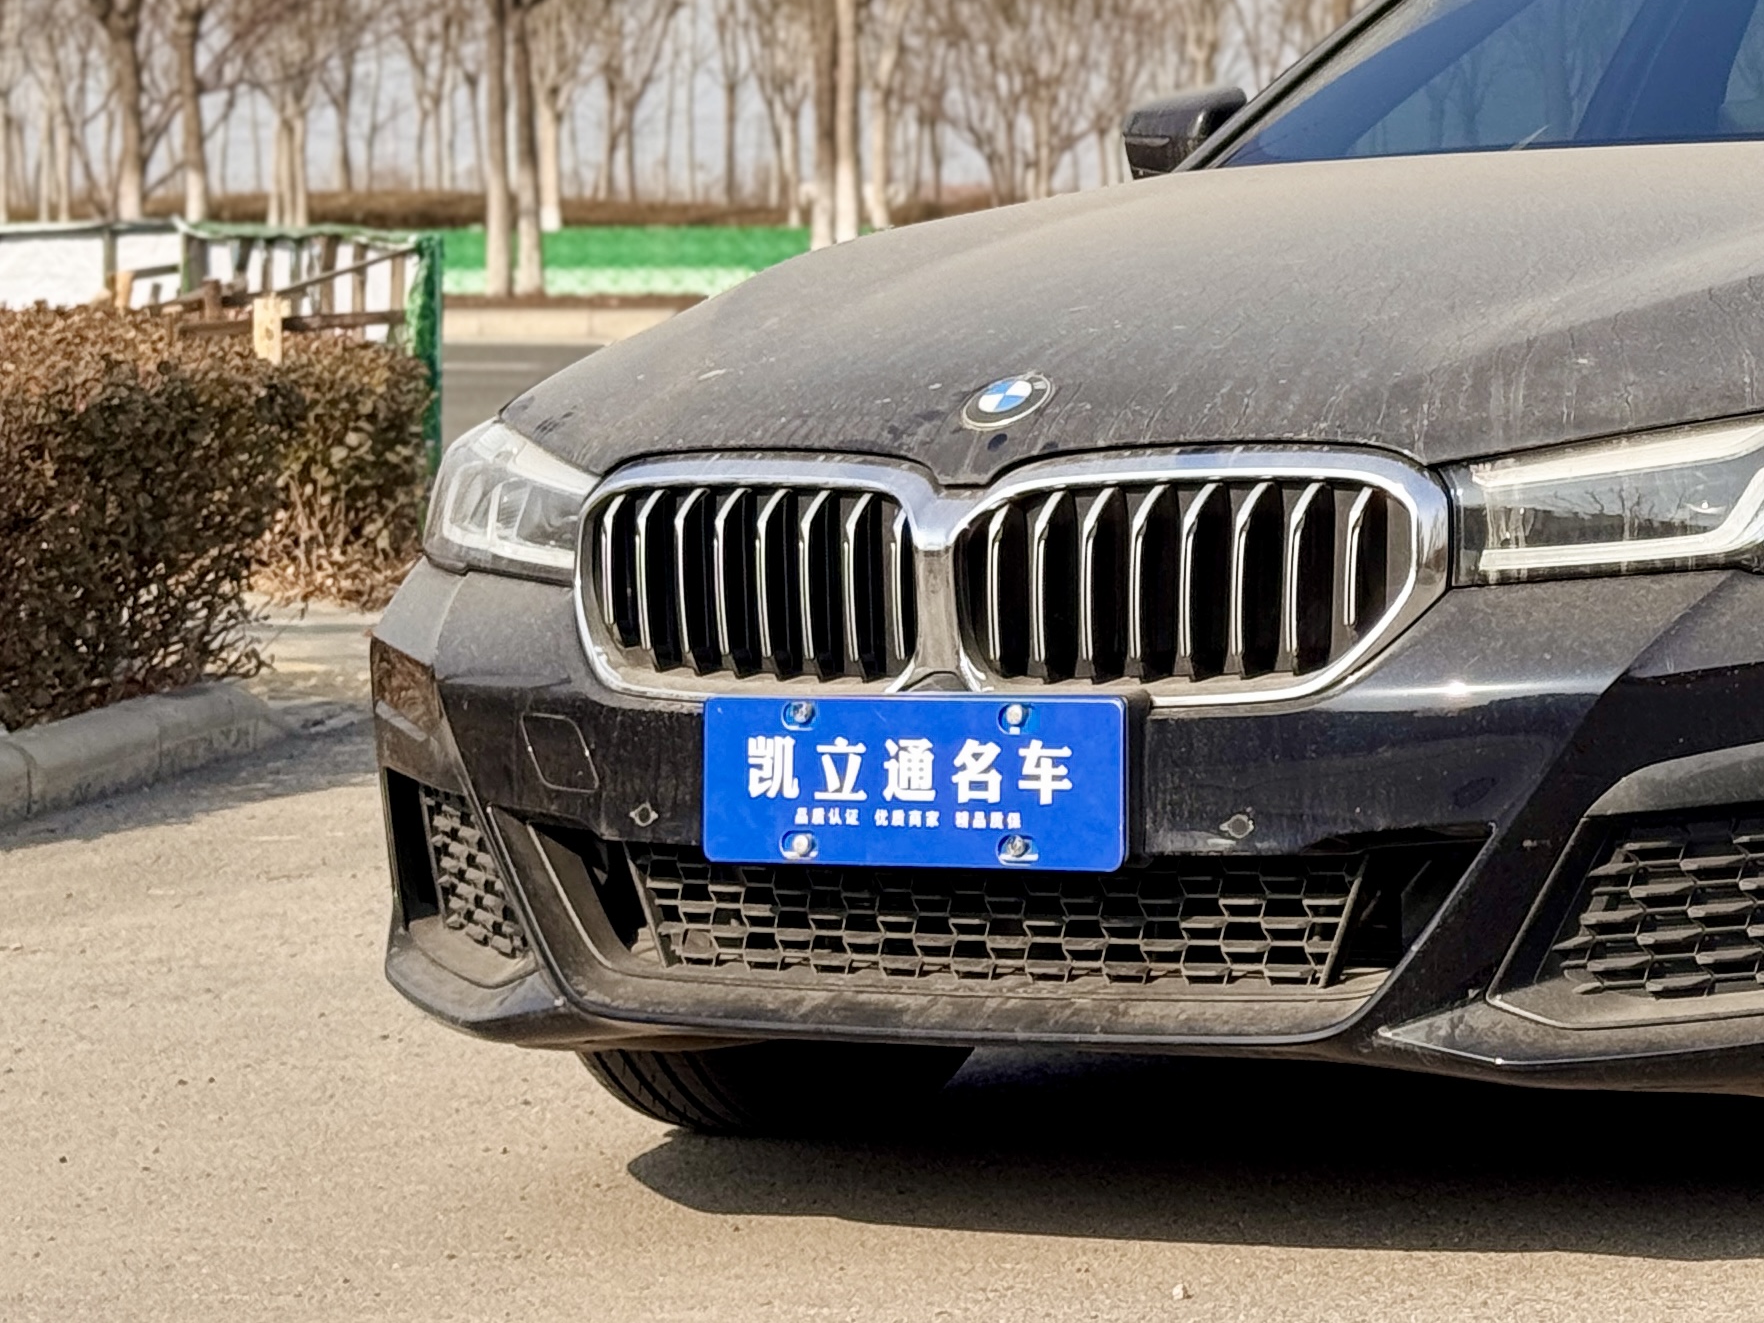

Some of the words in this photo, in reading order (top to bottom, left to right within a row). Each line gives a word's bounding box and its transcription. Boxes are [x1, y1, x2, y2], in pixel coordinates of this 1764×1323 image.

[747, 735, 1073, 805] 凯立通名车
[794, 807, 859, 826] 品质认证
[874, 808, 940, 828] 优质商家
